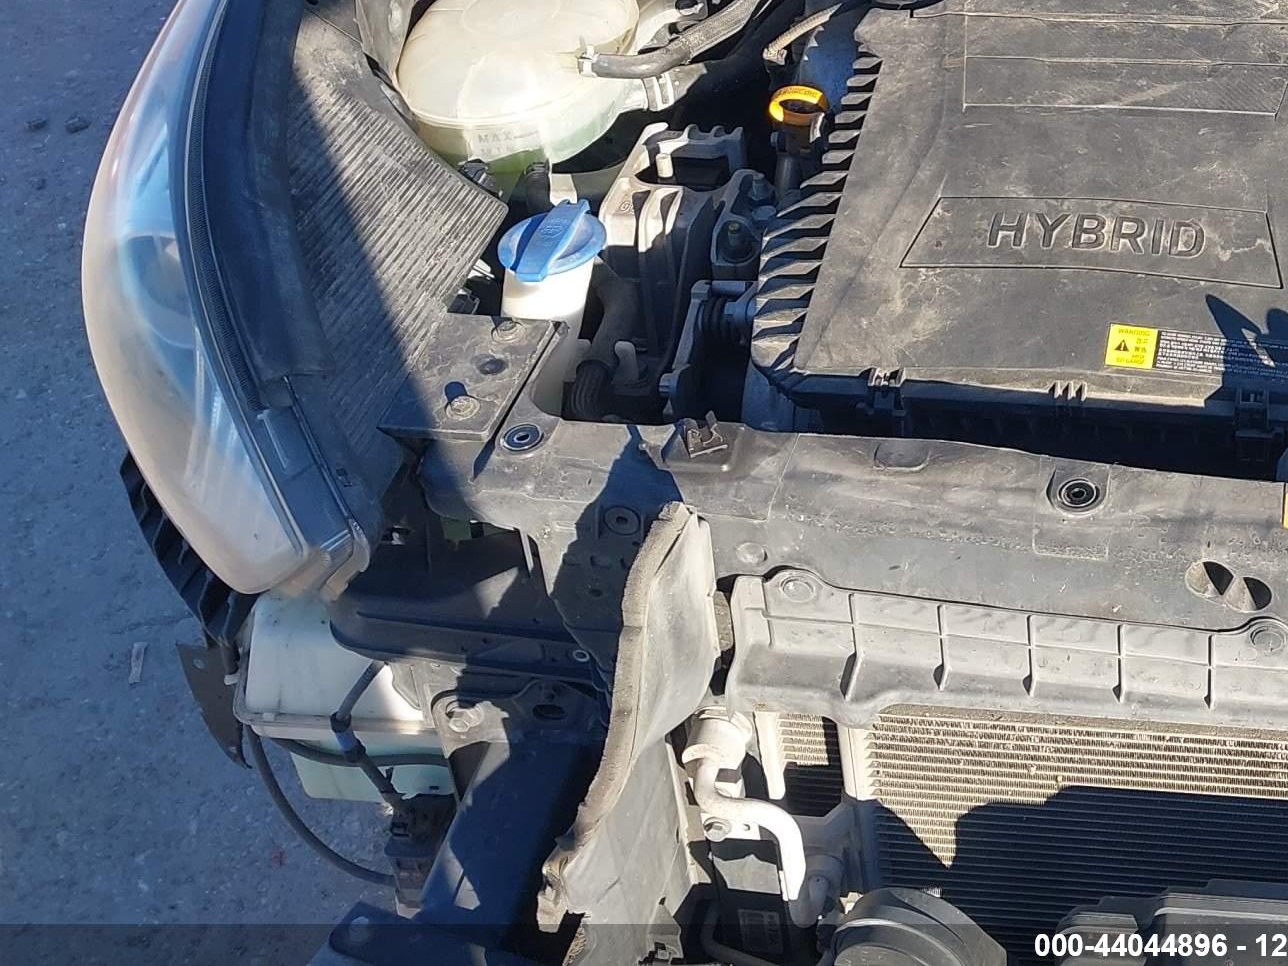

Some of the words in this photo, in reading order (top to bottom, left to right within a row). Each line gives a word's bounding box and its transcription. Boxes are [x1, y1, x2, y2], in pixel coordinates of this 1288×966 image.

[477, 130, 513, 143] MAX
[987, 212, 1206, 258] HYBRID
[1118, 328, 1150, 337] WARNING
